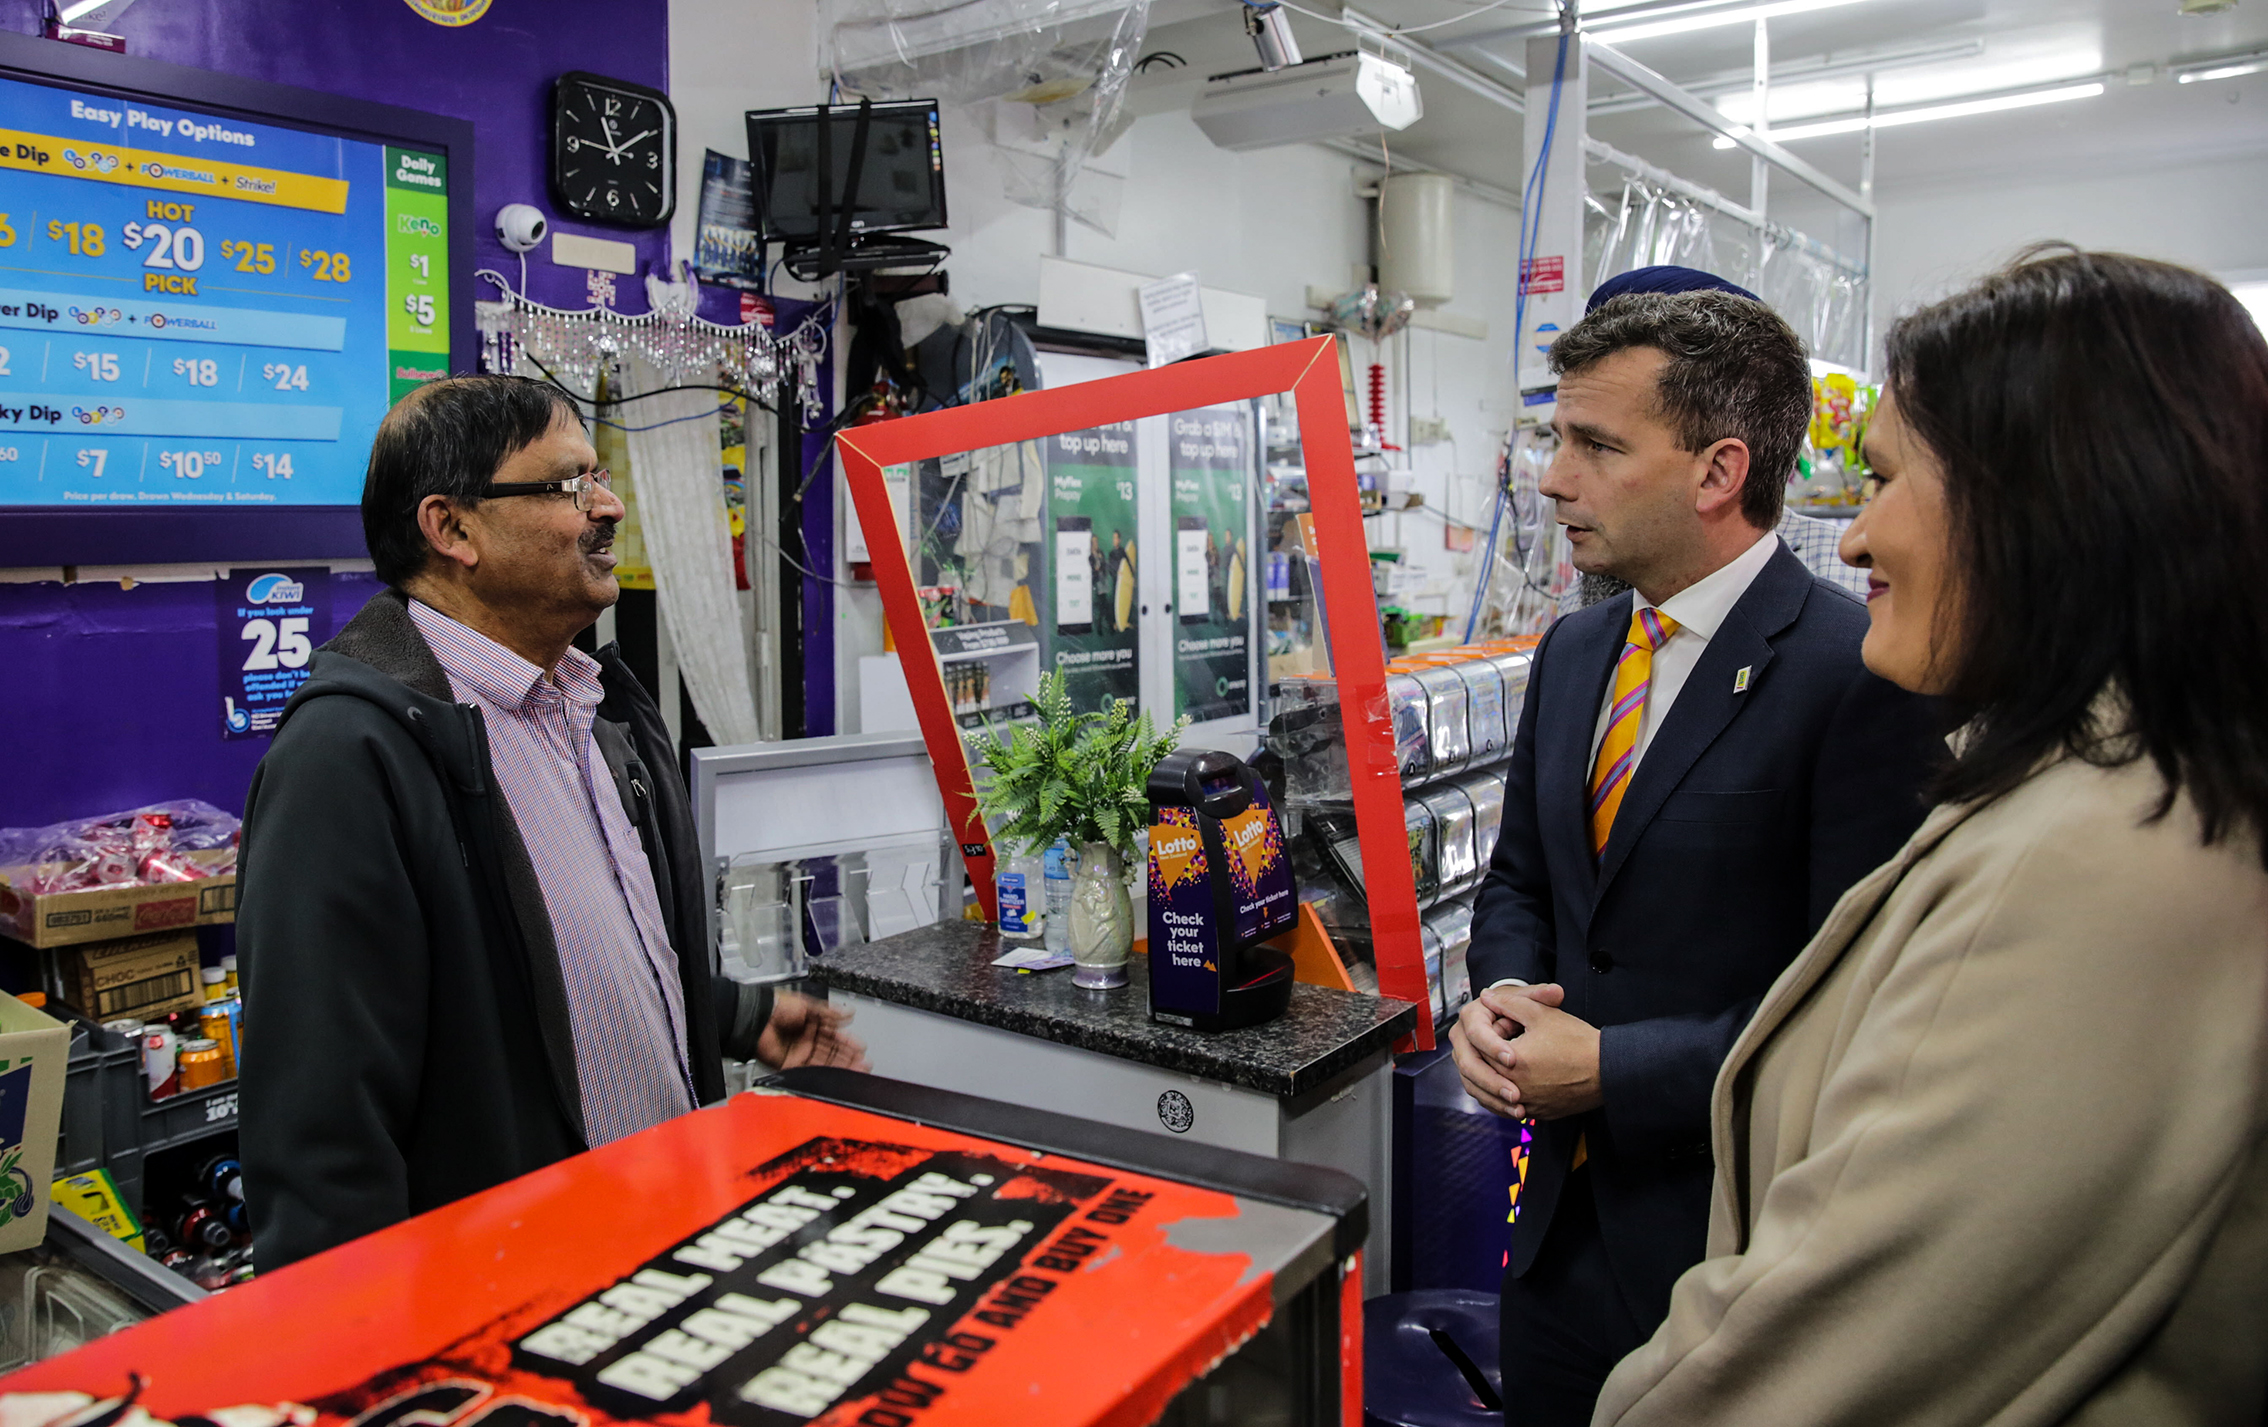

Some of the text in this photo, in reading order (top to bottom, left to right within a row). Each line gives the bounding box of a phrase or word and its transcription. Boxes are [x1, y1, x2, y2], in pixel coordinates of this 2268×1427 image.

[605, 98, 621, 116] 12
[71, 99, 255, 147] Easy Play Options
[567, 135, 580, 153] 9
[16, 143, 49, 166] Dip
[234, 176, 276, 194] Strike!
[401, 154, 435, 175] Daily
[646, 151, 658, 169] 3
[396, 168, 442, 187] Games
[606, 189, 620, 207] 6
[147, 200, 195, 223] HOT
[398, 214, 441, 237] Keno
[47, 219, 106, 257] $18
[123, 221, 205, 272] $20
[220, 239, 276, 275] $25
[300, 248, 351, 283] $28
[410, 253, 429, 278] $1
[144, 272, 198, 296] PICK
[27, 302, 59, 323] Dip
[405, 293, 436, 326] $5
[73, 351, 120, 382] $15
[173, 358, 218, 387] $18
[263, 362, 309, 391] $24
[30, 404, 62, 424] Dip
[1174, 418, 1200, 436] Grab
[1204, 424, 1212, 436] a
[1213, 420, 1231, 437] SIM
[1059, 434, 1128, 455] top up here
[1180, 442, 1239, 459] top up here
[77, 448, 108, 477] $7
[252, 453, 294, 479] $14
[63, 491, 89, 500] Price
[138, 492, 169, 500] Drawn
[171, 492, 224, 502] Wednesday
[272, 591, 300, 599] KIWI
[247, 609, 265, 619] you
[265, 606, 286, 616] look
[287, 605, 314, 616] under
[241, 617, 312, 671] 25
[1178, 635, 1244, 653] Choose more you
[1056, 649, 1132, 664] Choose more you
[243, 673, 274, 684] please
[275, 670, 298, 680] don't
[245, 680, 287, 692] offended
[247, 692, 264, 701] ask
[266, 692, 283, 702] you
[1233, 820, 1264, 848] Lotto
[1156, 837, 1197, 856] Lotto
[1239, 889, 1289, 914] Check your ticket here
[1162, 912, 1204, 926] Check
[1169, 927, 1199, 939] your
[1167, 940, 1204, 953] ticket
[1172, 953, 1202, 967] here
[520, 1185, 856, 1366] REAL MEAT.
[935, 1332, 997, 1373] GO
[973, 1276, 1058, 1328] AND
[1032, 1226, 1108, 1272] BUY
[1085, 1187, 1155, 1225] ONE
[596, 1171, 995, 1401] REAL PASTRY.
[739, 1219, 1034, 1418] REAL PIES.
